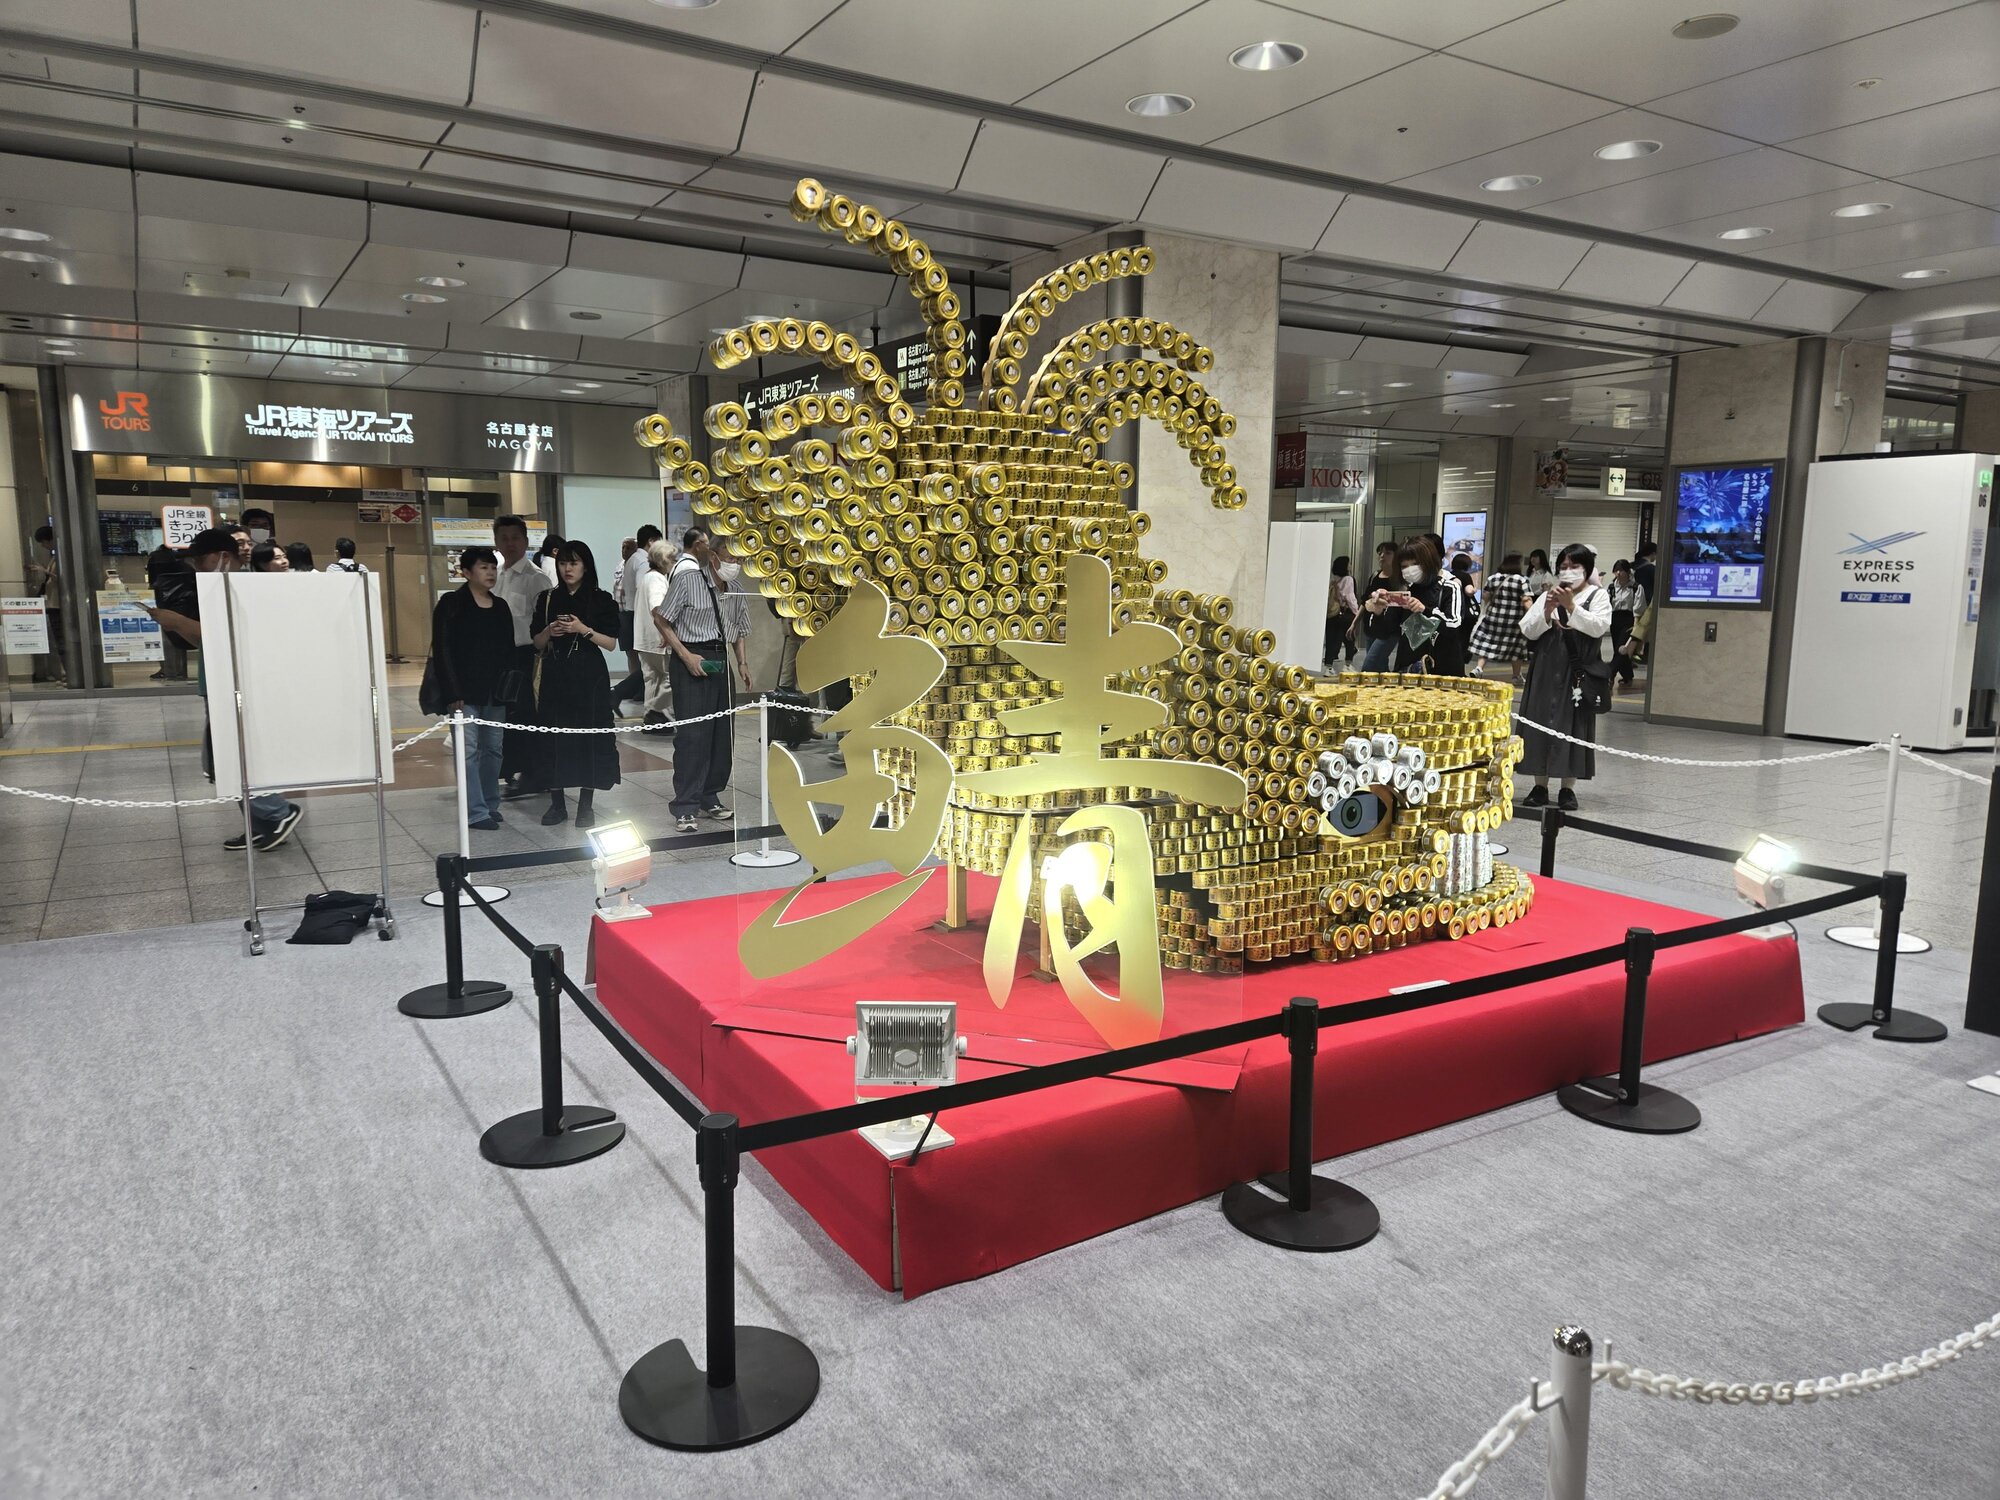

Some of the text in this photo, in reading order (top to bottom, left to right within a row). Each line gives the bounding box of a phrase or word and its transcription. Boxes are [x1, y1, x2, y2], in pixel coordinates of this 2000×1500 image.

[758, 374, 820, 405] JR東海ツアーズ
[100, 391, 149, 416] JR
[102, 416, 151, 431] TOURS
[245, 404, 413, 435] JR東海ツアーズ
[246, 424, 282, 437] Travel
[326, 429, 340, 440] JR
[342, 430, 376, 442] TOKAI
[376, 432, 414, 444] TOURS
[486, 421, 553, 438] 名古屋支店
[487, 438, 553, 452] NAGOYA
[1311, 468, 1364, 488] KIOSK
[132, 483, 139, 492] 6
[327, 489, 333, 498] 7
[168, 509, 207, 519] JR全線
[169, 520, 208, 532] きっぷ
[169, 532, 198, 544] うり
[1843, 560, 1915, 571] EXPRESS
[1854, 572, 1901, 583] WORK
[738, 554, 1247, 1050] 鯖
